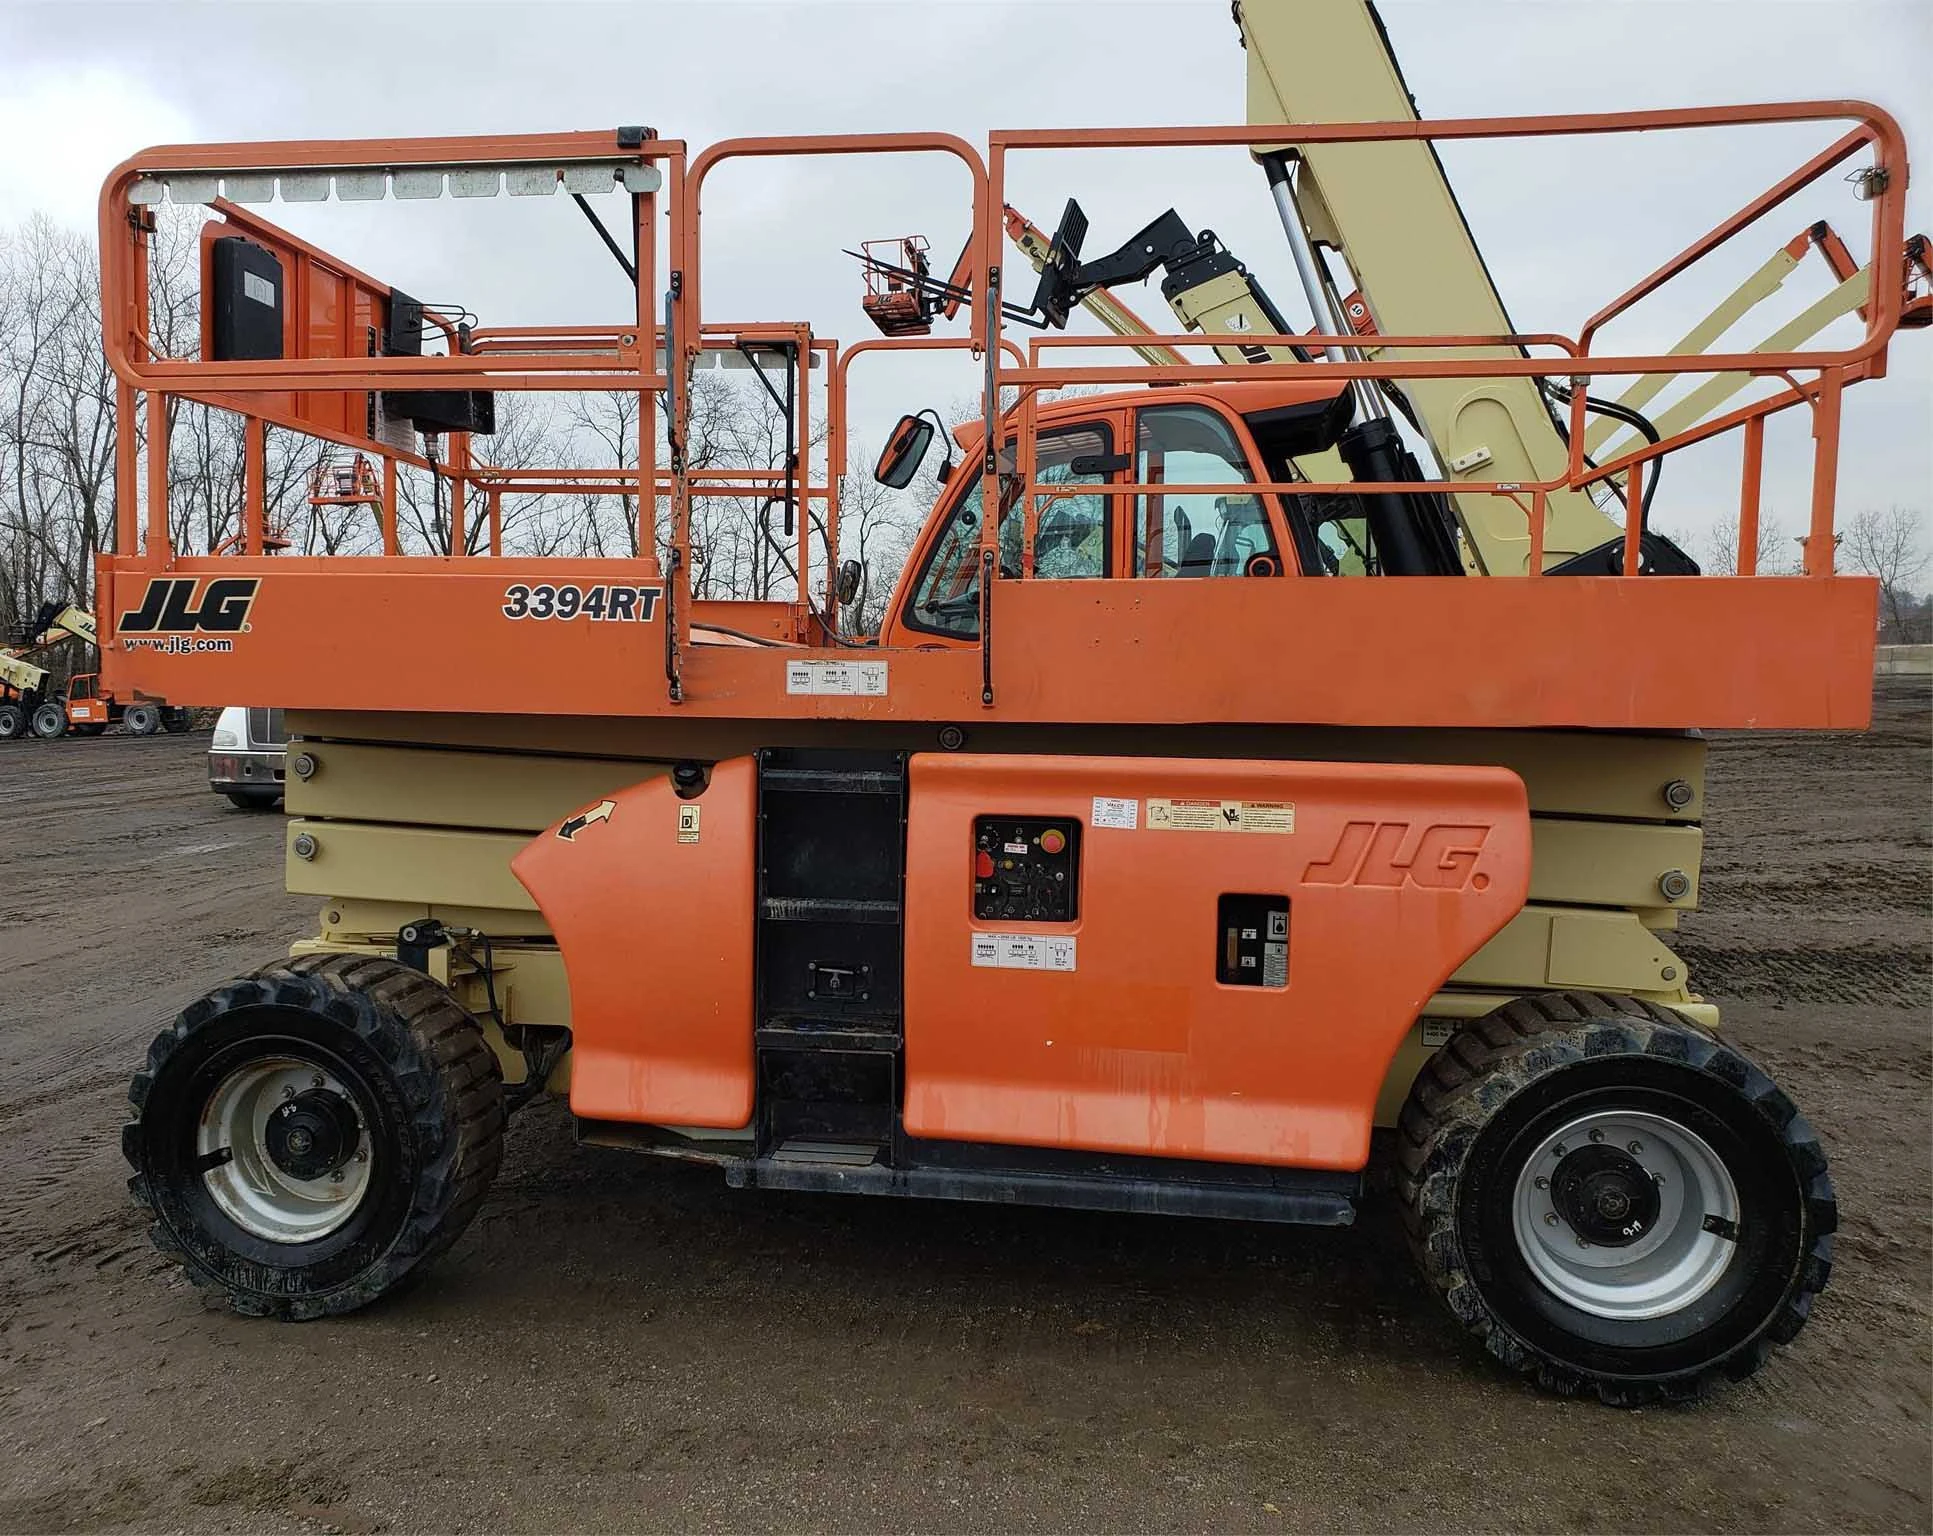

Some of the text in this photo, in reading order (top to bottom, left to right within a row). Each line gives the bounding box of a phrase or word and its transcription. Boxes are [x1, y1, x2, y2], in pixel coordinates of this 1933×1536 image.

[1352, 305, 1363, 315] 10
[117, 578, 262, 633] JLG
[503, 584, 663, 622] 3394RT
[124, 636, 232, 655] www.jlg.com
[683, 817, 691, 827] D
